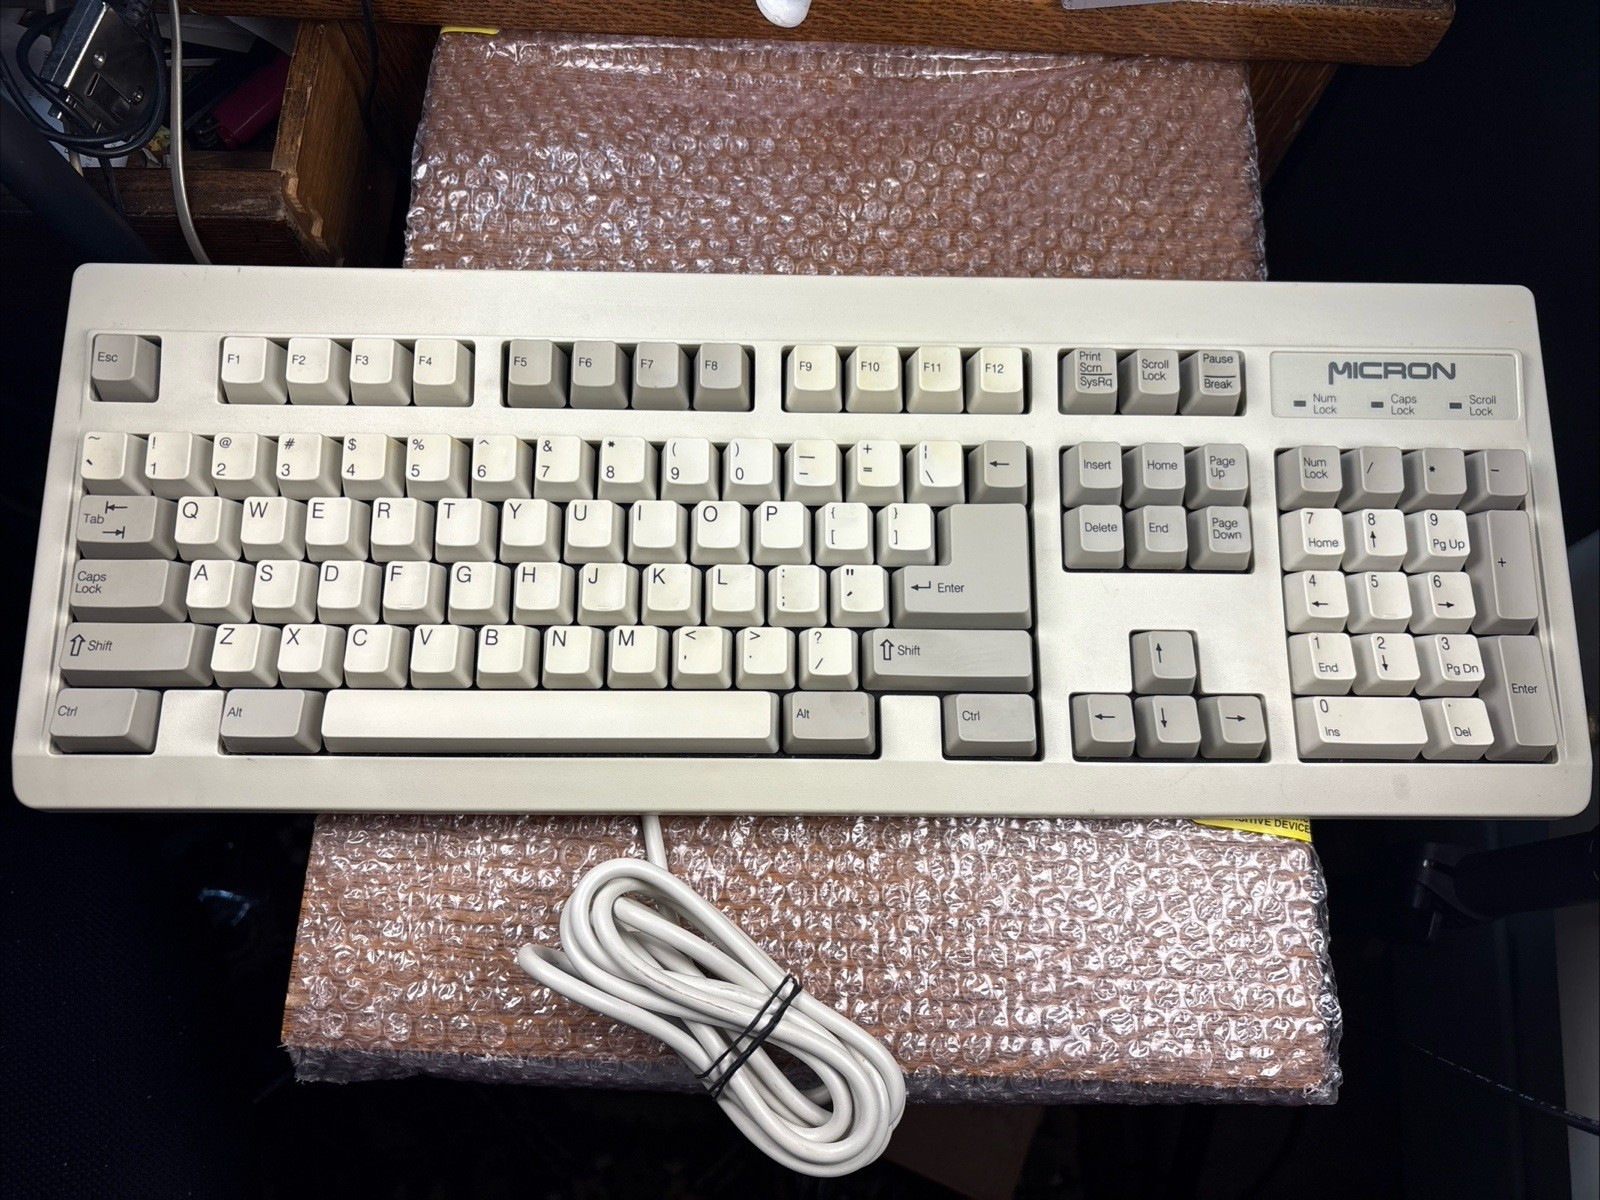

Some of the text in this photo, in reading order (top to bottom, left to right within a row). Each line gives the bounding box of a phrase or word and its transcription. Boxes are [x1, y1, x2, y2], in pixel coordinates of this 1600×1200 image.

[98, 352, 117, 362] Esc
[227, 354, 241, 364] F1
[292, 355, 306, 365] F2
[355, 355, 369, 365] F3
[419, 356, 432, 365] F4
[514, 356, 527, 367] F5
[579, 357, 592, 367] F6
[1079, 351, 1101, 363] Print
[1203, 353, 1233, 363] Pause
[641, 359, 653, 369] F7
[705, 360, 718, 371] F8
[800, 361, 812, 371] F9
[861, 361, 879, 372] F10
[924, 362, 940, 372] F11
[985, 363, 1004, 373] F12
[1080, 363, 1102, 372] Scrn
[1142, 359, 1169, 369] Scroll
[1142, 370, 1166, 381] Lock
[1328, 362, 1456, 385] MICRON
[1080, 375, 1112, 388] SysRq
[1205, 379, 1232, 389] Break
[1313, 394, 1336, 403] Num
[1391, 394, 1417, 405] Caps
[1469, 395, 1496, 404] Scroll
[1313, 405, 1337, 414] Lock
[1391, 406, 1415, 415] Lock
[1470, 406, 1493, 416] Lock
[1084, 459, 1111, 470] Insert
[1147, 460, 1177, 470] Home
[1210, 455, 1235, 468] Page
[1303, 457, 1326, 467] Num
[216, 463, 226, 476] 2
[281, 464, 290, 476] 3
[347, 464, 355, 476] 4
[411, 464, 420, 477] 5
[477, 465, 486, 478] 6
[542, 465, 550, 477] 7
[606, 466, 614, 478] 8
[671, 467, 679, 480] 9
[736, 467, 744, 480] 0
[1211, 468, 1225, 479] Up
[1304, 469, 1328, 479] Lock
[183, 501, 198, 519] Q
[250, 502, 268, 518] W
[313, 502, 324, 518] E
[378, 502, 390, 518] R
[444, 503, 455, 519] T
[509, 503, 522, 519] Y
[574, 505, 587, 521] U
[703, 506, 718, 522] O
[767, 506, 777, 521] P
[84, 513, 104, 524] Tab
[1212, 518, 1238, 529] Page
[1306, 512, 1314, 524] 7
[1368, 513, 1375, 525] 8
[1430, 513, 1438, 526] 9
[1085, 522, 1117, 532] Delete
[1149, 522, 1168, 533] End
[1213, 528, 1241, 539] Down
[1308, 538, 1339, 547] Home
[1433, 539, 1465, 551] Pg Up
[76, 571, 107, 585] Caps
[194, 564, 208, 580] A
[260, 565, 273, 581] S
[325, 565, 339, 581] D
[391, 566, 403, 581] F
[457, 566, 471, 583] G
[522, 567, 535, 582] H
[588, 568, 598, 584] J
[653, 568, 665, 584] K
[718, 569, 727, 585] L
[1309, 574, 1316, 586] 4
[1371, 575, 1378, 588] 5
[1433, 575, 1441, 588] 6
[75, 583, 101, 594] Lock
[938, 583, 964, 593] Enter
[220, 628, 234, 645] Z
[286, 628, 300, 645] X
[353, 629, 367, 646] C
[420, 629, 433, 645] V
[485, 629, 498, 645] B
[553, 630, 566, 647] N
[619, 630, 634, 646] M
[1314, 636, 1320, 649] 1
[1377, 636, 1386, 649] 2
[87, 640, 112, 652] Shift
[1441, 637, 1450, 650] 3
[898, 645, 920, 655] Shift
[1318, 663, 1338, 672] End
[1446, 663, 1479, 675] Pg Dn
[1511, 683, 1537, 693] Enter
[57, 706, 78, 717] Ctrl
[227, 706, 243, 717] Alt
[1320, 699, 1329, 713] 0
[796, 709, 809, 718] Alt
[962, 711, 980, 721] Ctrl
[1325, 727, 1340, 737] Ins
[1454, 727, 1471, 737] Del
